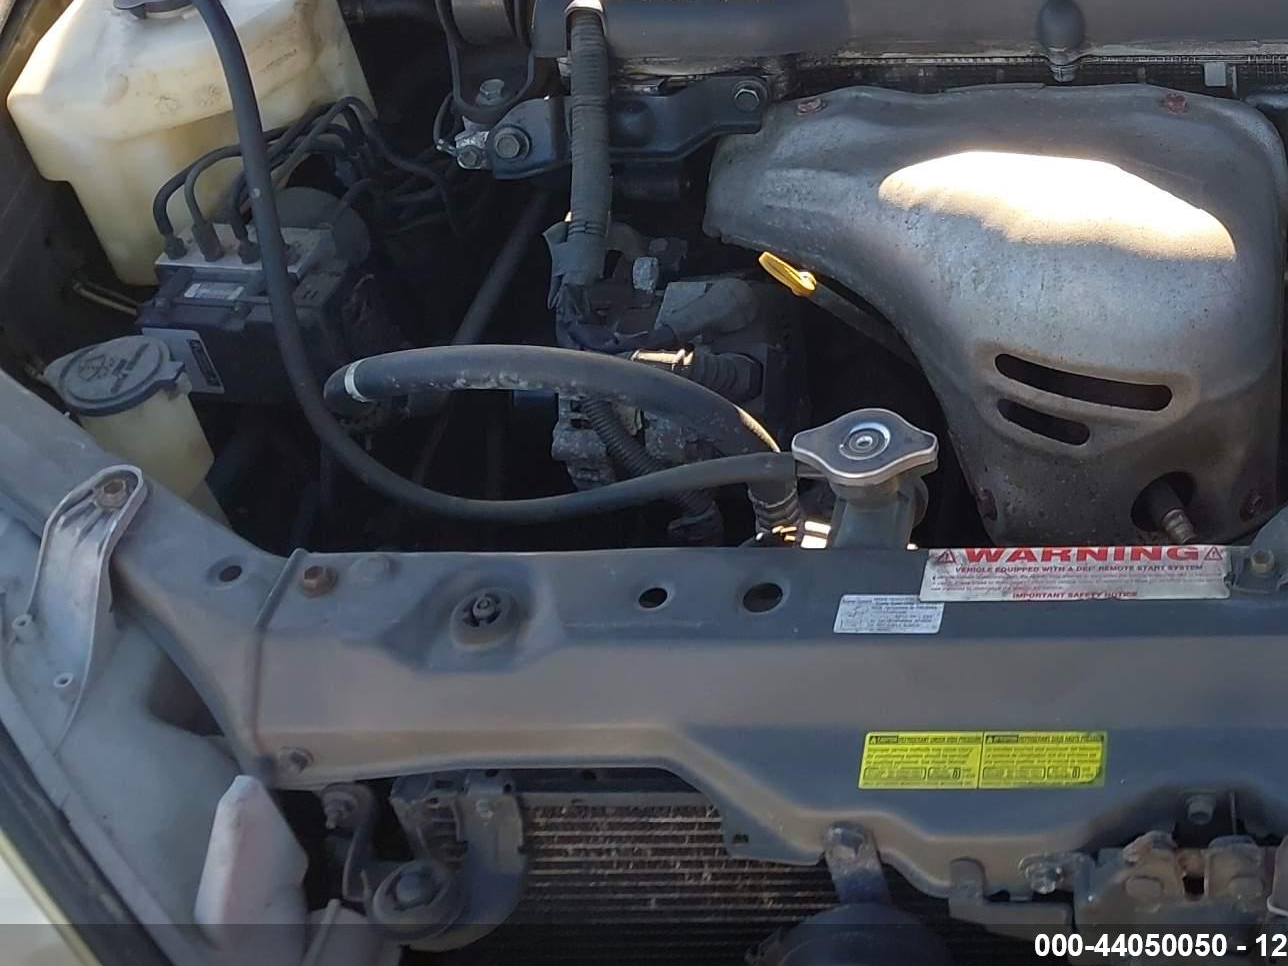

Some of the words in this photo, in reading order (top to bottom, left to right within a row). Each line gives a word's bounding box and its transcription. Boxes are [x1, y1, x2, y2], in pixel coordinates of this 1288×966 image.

[964, 546, 1199, 563] WARNING
[995, 565, 1039, 573] EQUIPPED
[1167, 563, 1203, 571] SYSTEM
